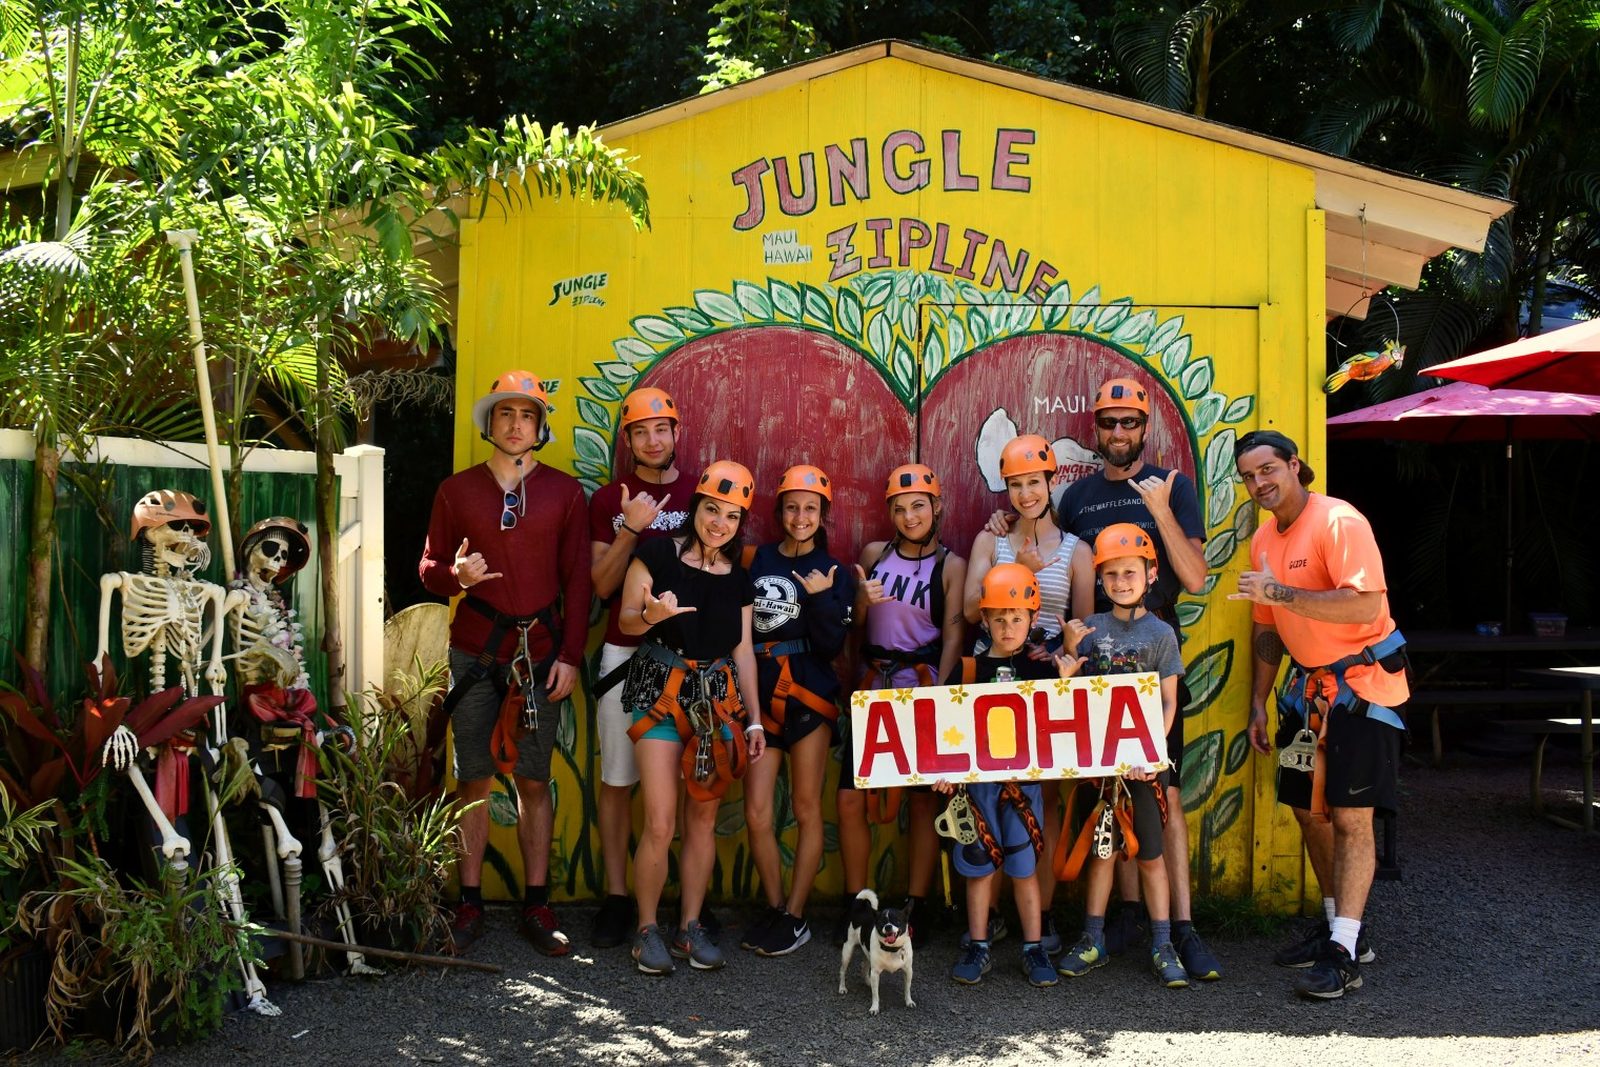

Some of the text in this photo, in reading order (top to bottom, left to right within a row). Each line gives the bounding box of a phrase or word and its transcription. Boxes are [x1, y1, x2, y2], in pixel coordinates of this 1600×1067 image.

[732, 128, 1036, 231] JUNGLE
[763, 230, 797, 246] MAUI
[826, 218, 1058, 304] ZIPLINE
[548, 273, 608, 306] JUNGLE
[1034, 395, 1085, 415] MAUI
[858, 685, 1160, 777] ALOHA
